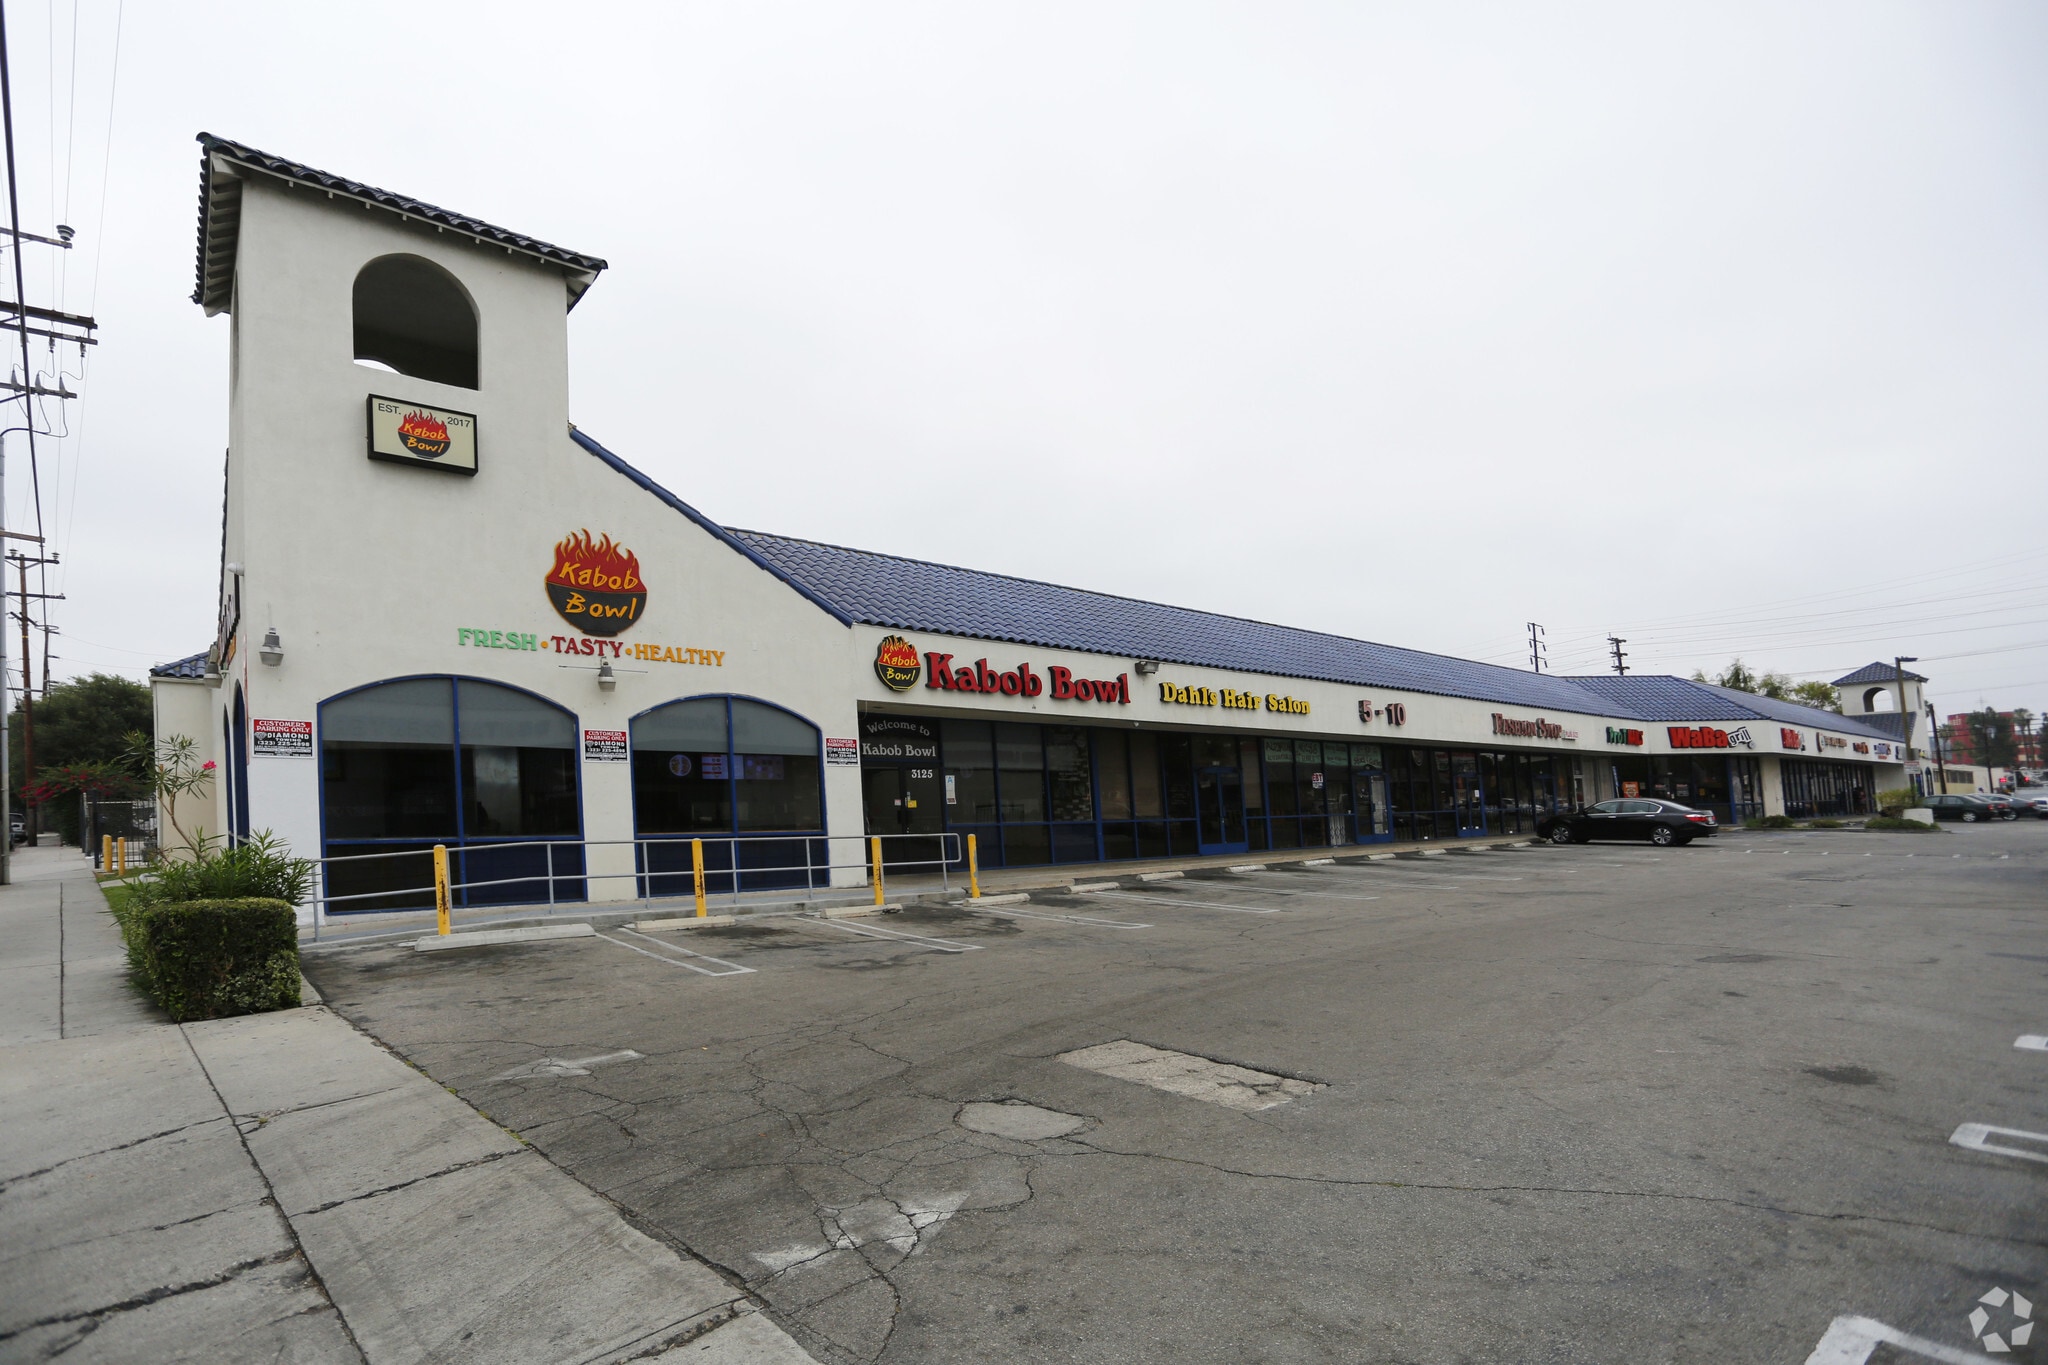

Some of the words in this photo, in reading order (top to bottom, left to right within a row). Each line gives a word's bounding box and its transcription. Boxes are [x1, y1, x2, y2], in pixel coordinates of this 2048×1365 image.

[378, 403, 402, 415] EST.
[447, 416, 471, 428] 2017
[403, 423, 446, 440] Kabob
[407, 436, 445, 453] Bowl
[559, 561, 639, 590] Kabob
[565, 592, 637, 620] Bowl
[458, 627, 538, 651] FRESH
[550, 635, 624, 658] TASTY
[634, 642, 726, 667] HEALTHY
[883, 652, 917, 666] Kabob
[886, 668, 916, 681] Bowl
[924, 651, 1043, 697] Kabob
[1048, 665, 1131, 704] Bowl
[1159, 682, 1218, 706] Dahl's
[1220, 687, 1262, 710] Hair
[1265, 693, 1311, 715] Salon
[259, 720, 306, 728] CUSTOMERS
[866, 720, 917, 734] Welcome
[919, 725, 931, 736] to
[1667, 726, 1728, 748] WaBa
[1728, 728, 1751, 746] grill
[862, 743, 902, 757] Kabob
[905, 744, 937, 757] Bowl
[911, 769, 933, 779] 3125
